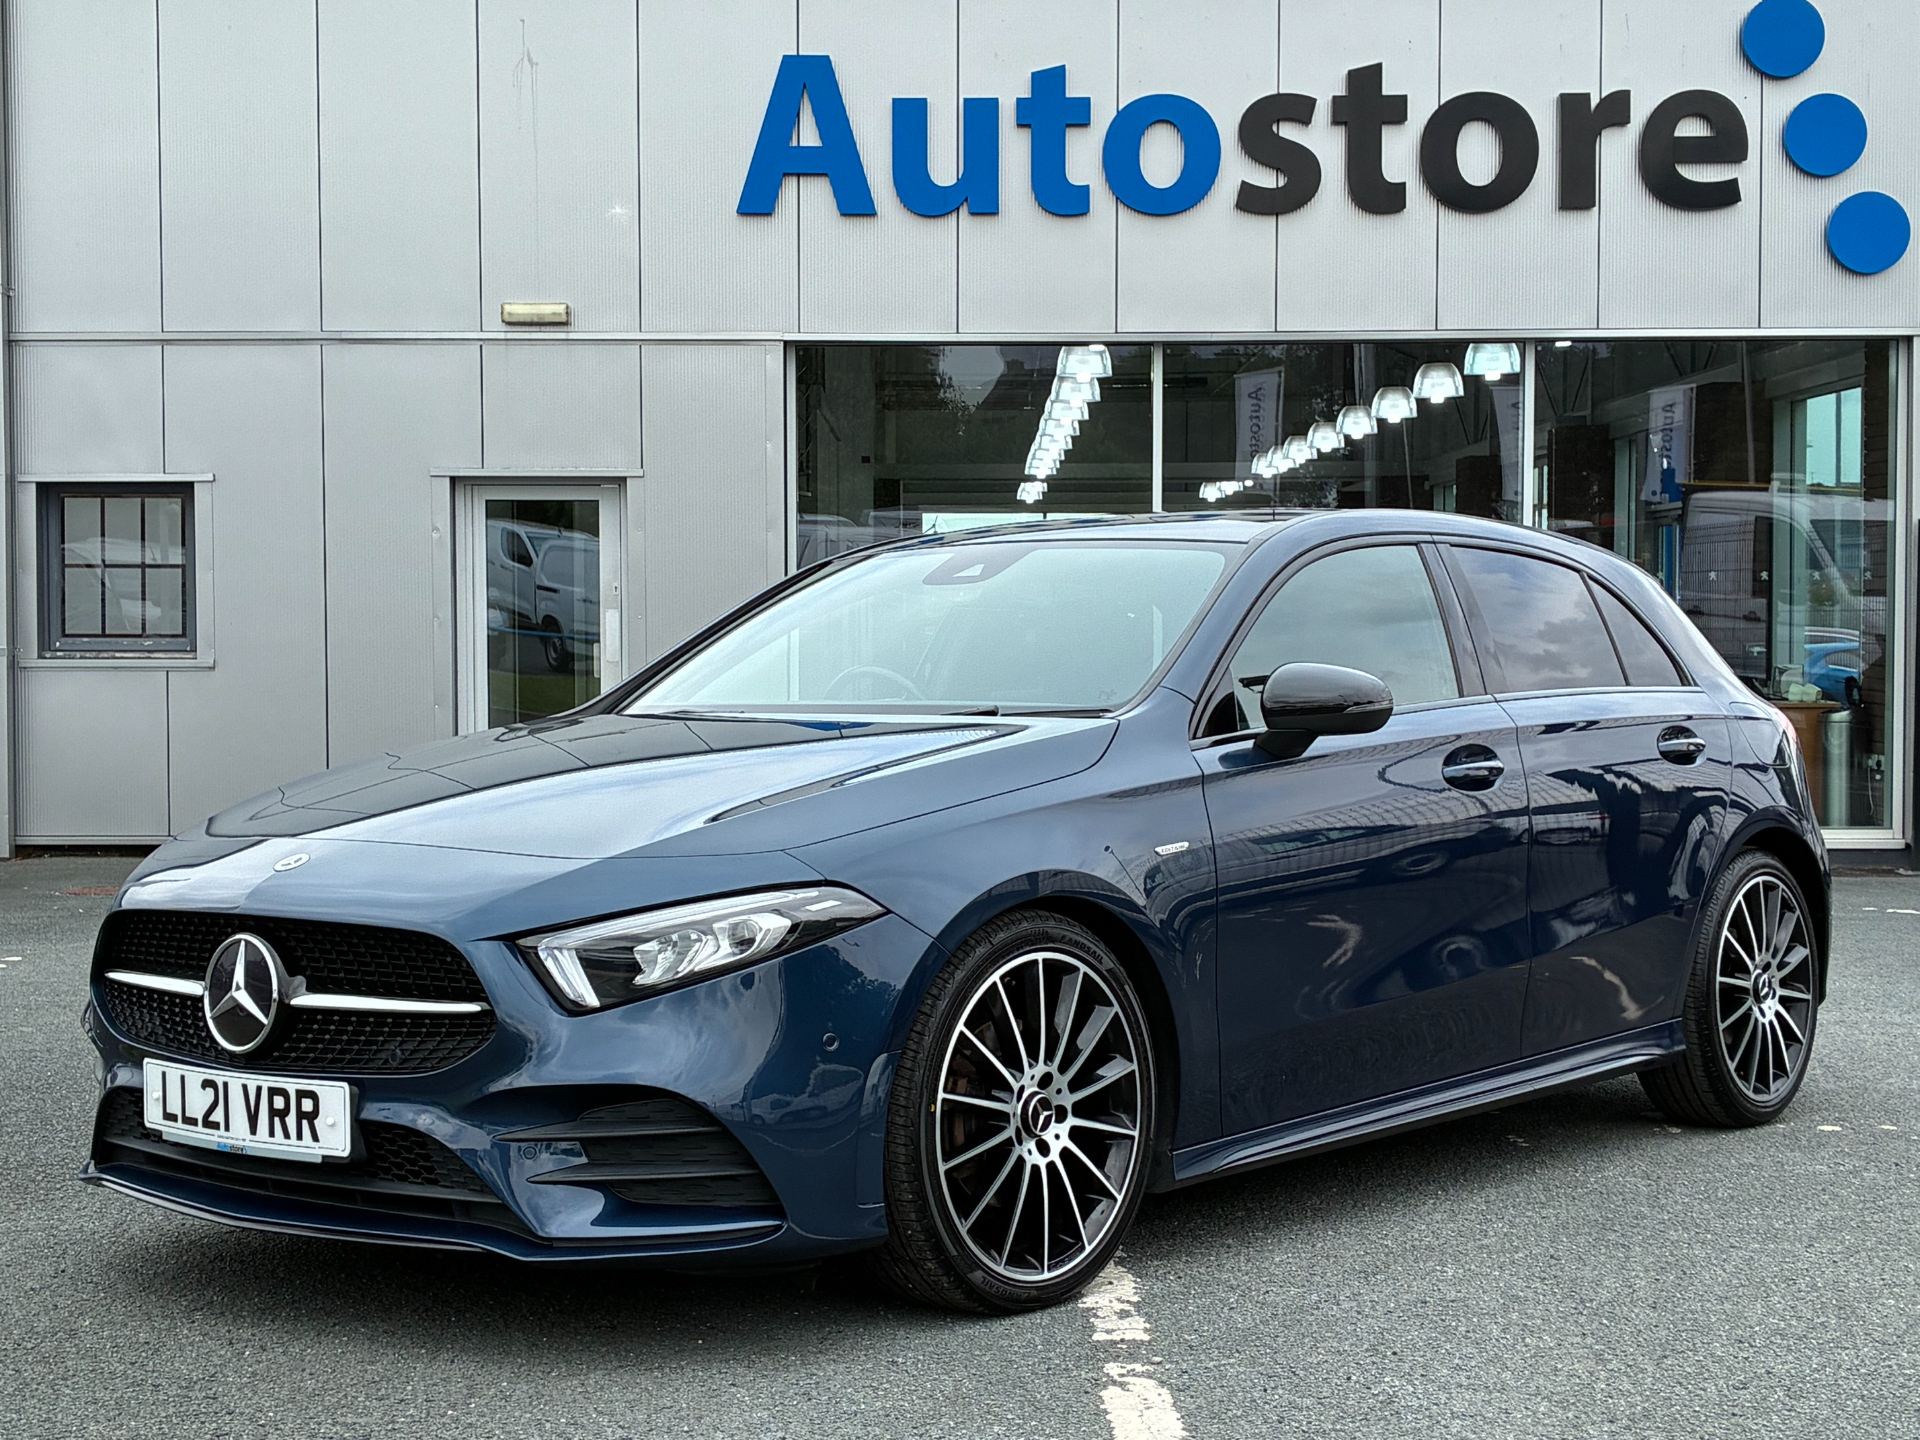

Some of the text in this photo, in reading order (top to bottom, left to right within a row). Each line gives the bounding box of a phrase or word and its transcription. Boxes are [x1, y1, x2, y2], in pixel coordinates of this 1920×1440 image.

[736, 54, 1749, 218] Autostore
[161, 1070, 320, 1143] LL21 VRR
